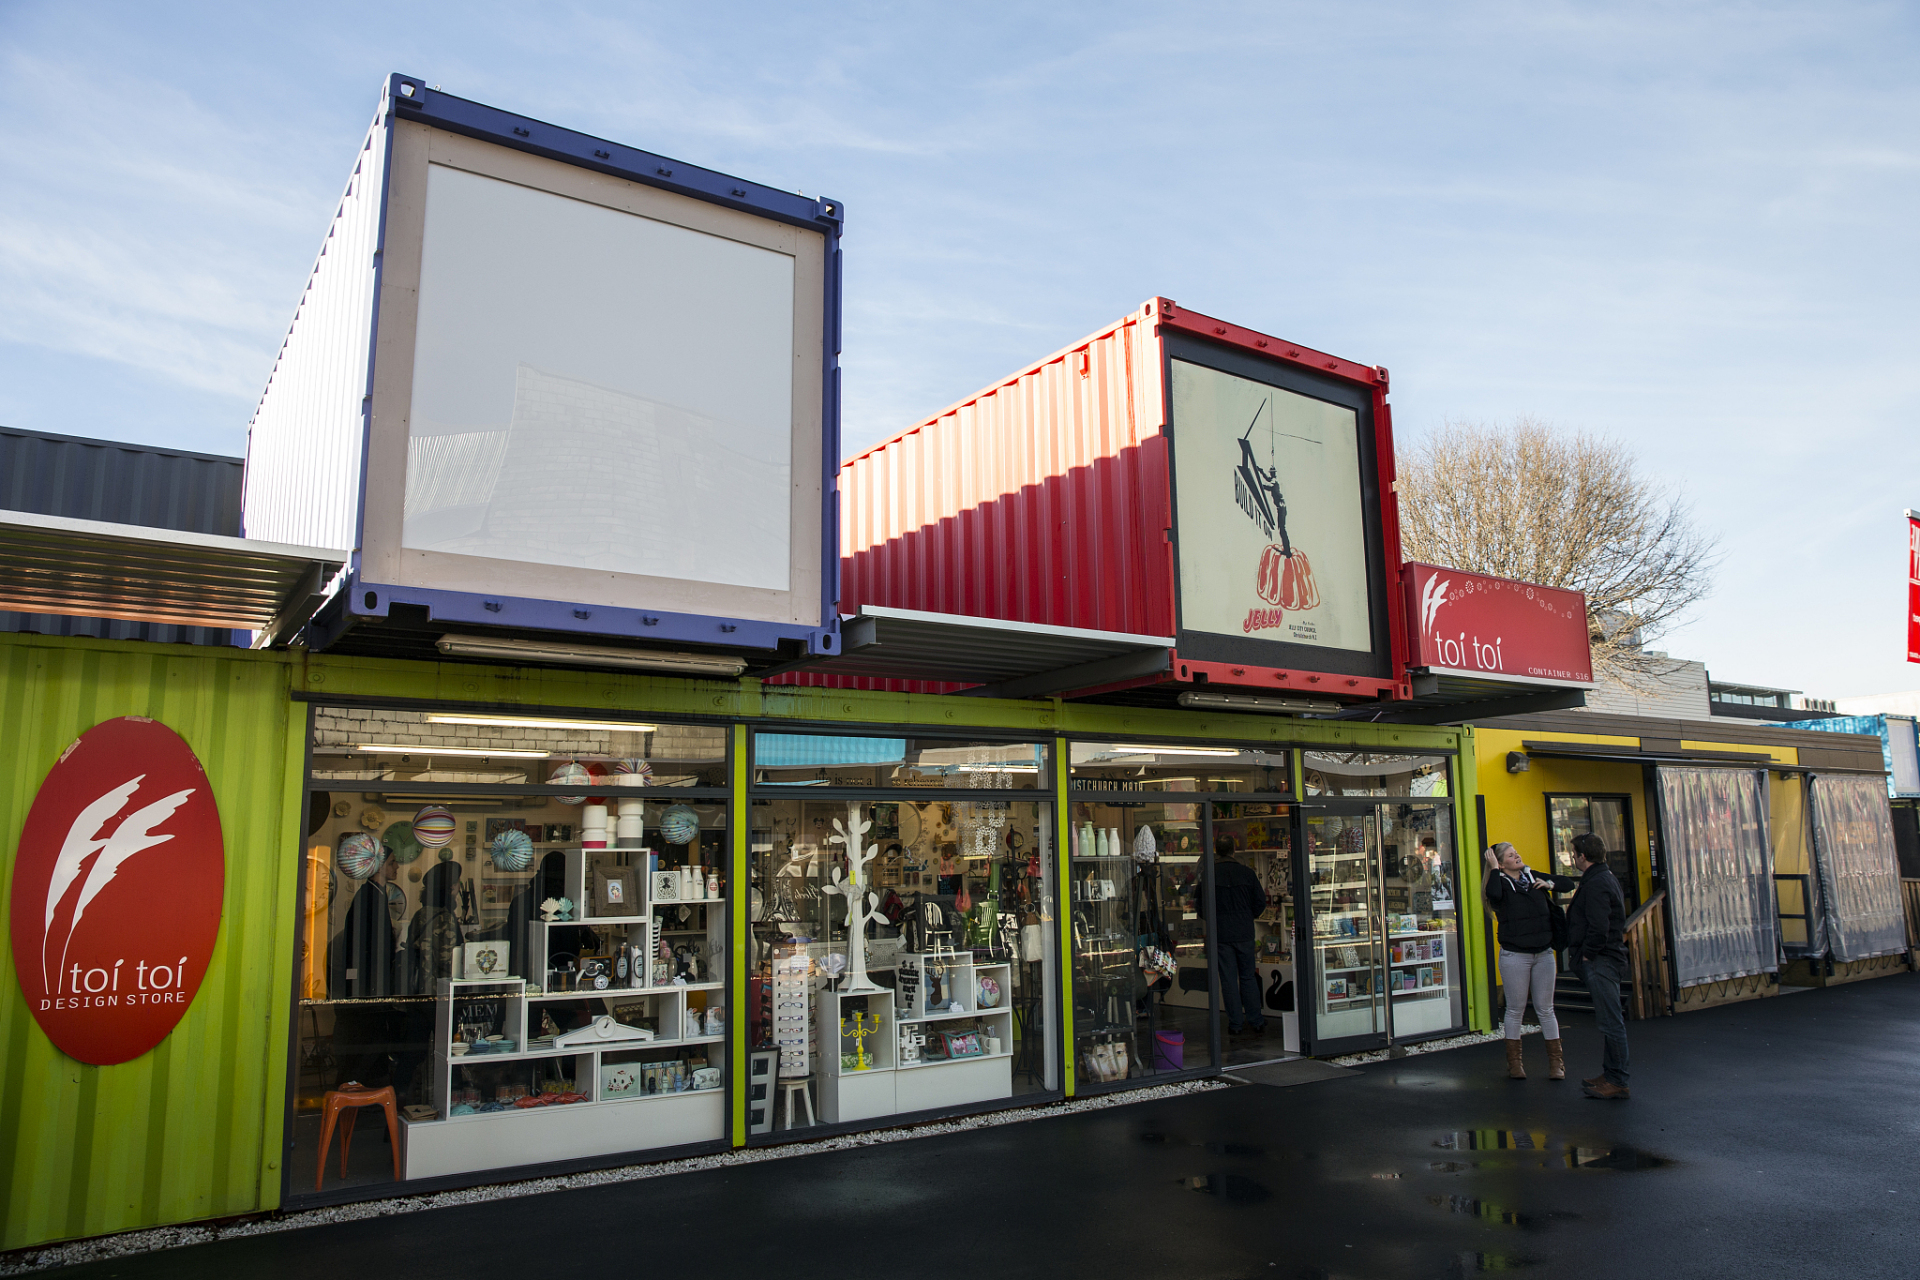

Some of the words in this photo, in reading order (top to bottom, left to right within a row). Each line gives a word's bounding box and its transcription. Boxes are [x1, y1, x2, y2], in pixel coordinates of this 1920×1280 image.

[1255, 505, 1262, 530] IT
[1243, 607, 1284, 633] JELLY
[1528, 667, 1572, 679] CONTAINER
[1575, 672, 1590, 681] S16
[835, 773, 843, 786] is
[867, 777, 873, 786] a
[904, 775, 945, 787] rehearsa
[40, 995, 118, 1011] DESIGN
[126, 991, 186, 1006] STORE
